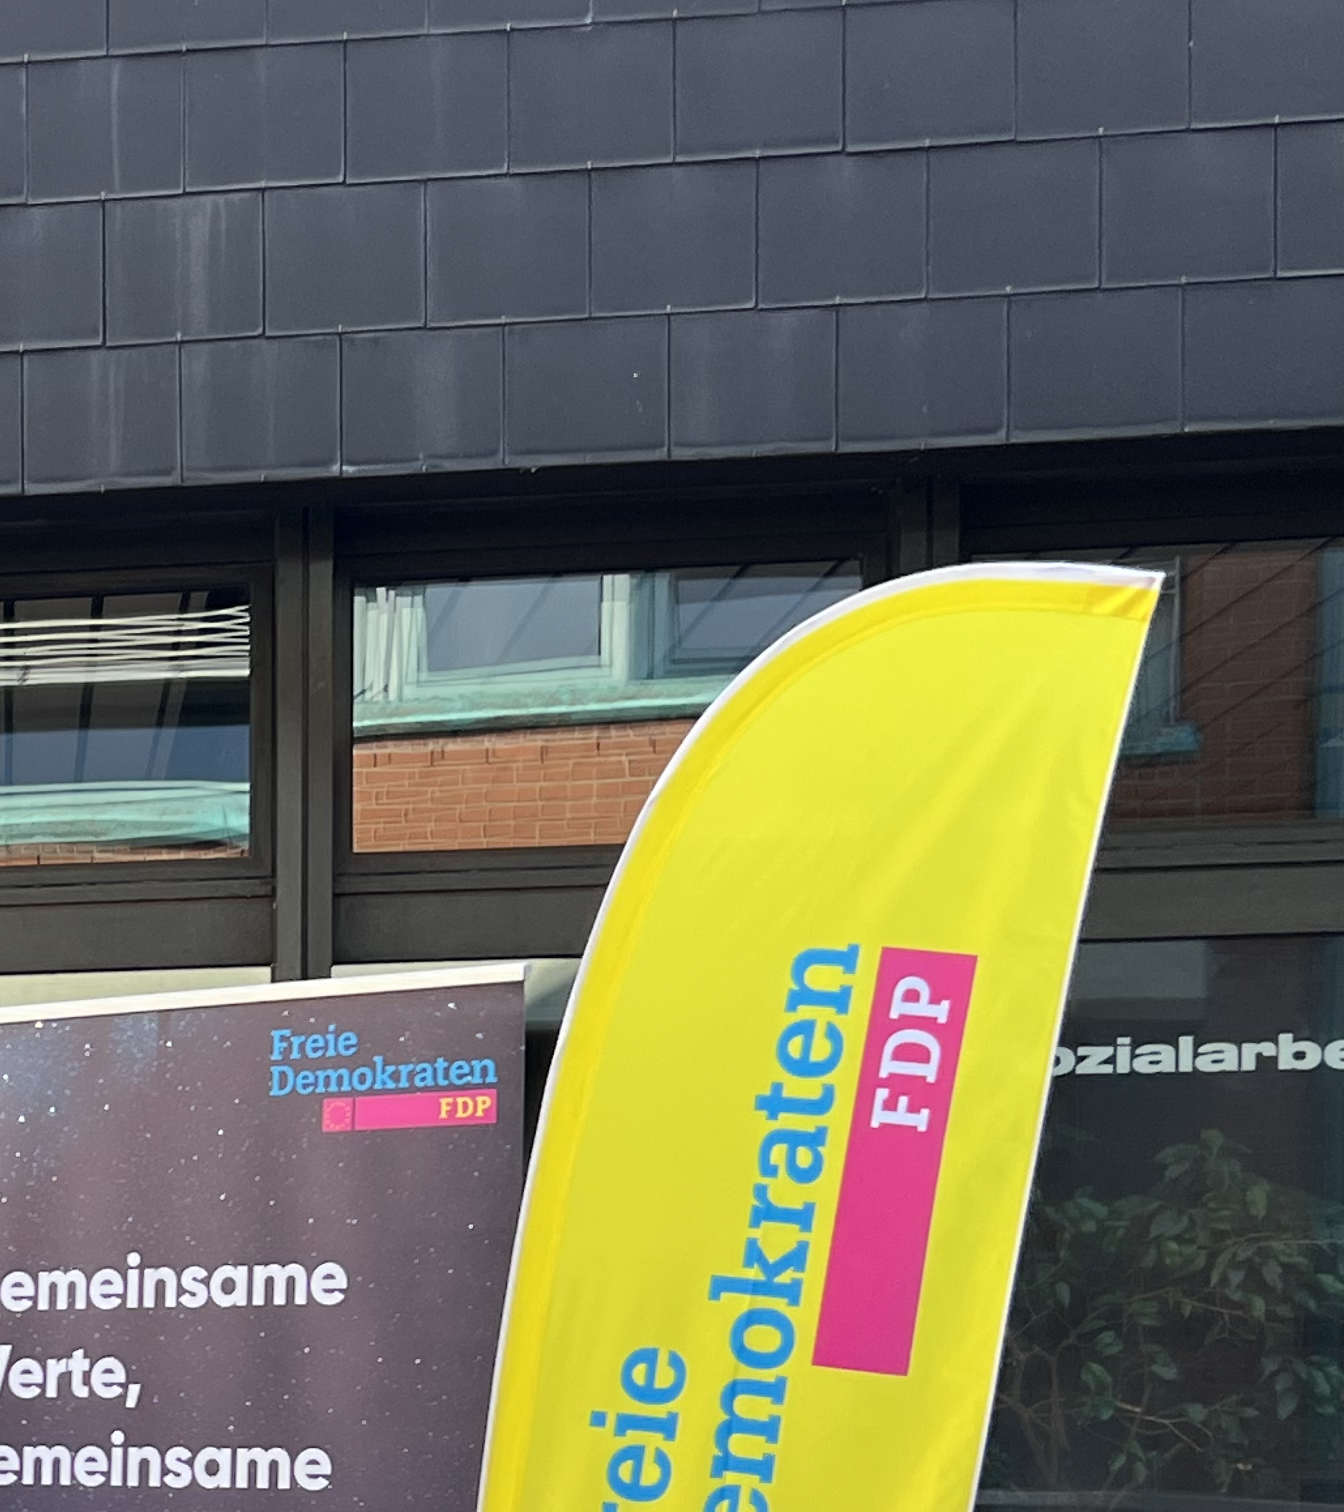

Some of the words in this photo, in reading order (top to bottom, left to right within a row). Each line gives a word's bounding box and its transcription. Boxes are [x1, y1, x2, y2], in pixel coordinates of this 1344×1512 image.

[270, 1024, 358, 1060] Freie
[871, 975, 950, 1132] FDP
[269, 1055, 498, 1096] Demokraten
[439, 1096, 491, 1119] FDP
